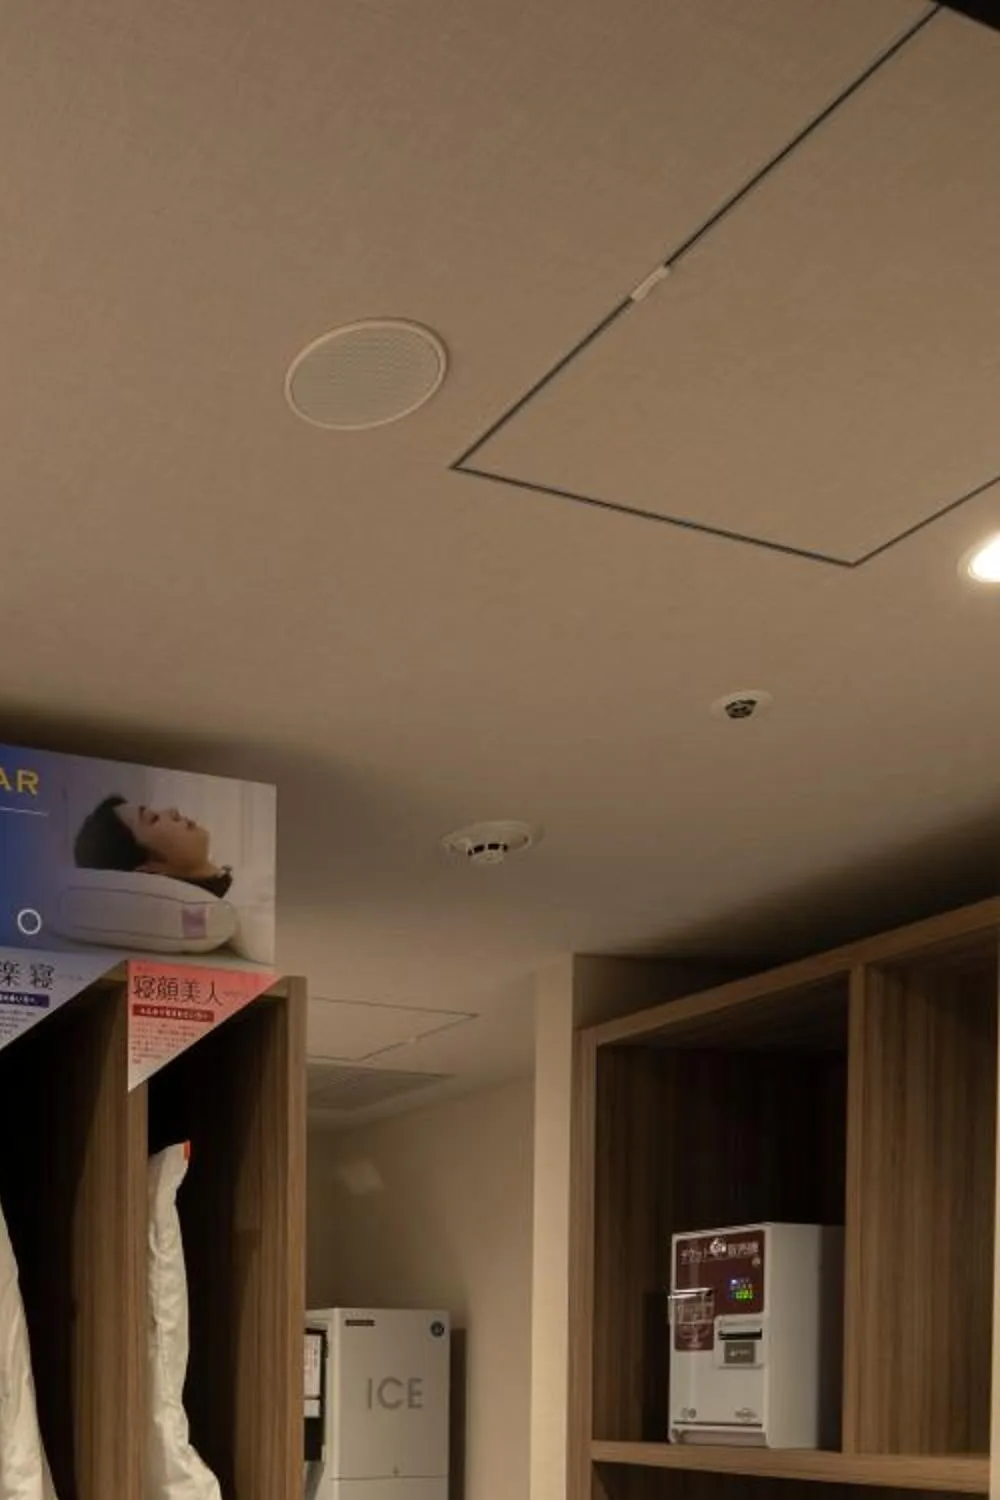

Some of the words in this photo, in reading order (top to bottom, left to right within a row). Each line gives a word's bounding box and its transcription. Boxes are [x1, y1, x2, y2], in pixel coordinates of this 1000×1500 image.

[133, 976, 223, 1006] 寝顔美人
[367, 1376, 424, 1409] ICE
